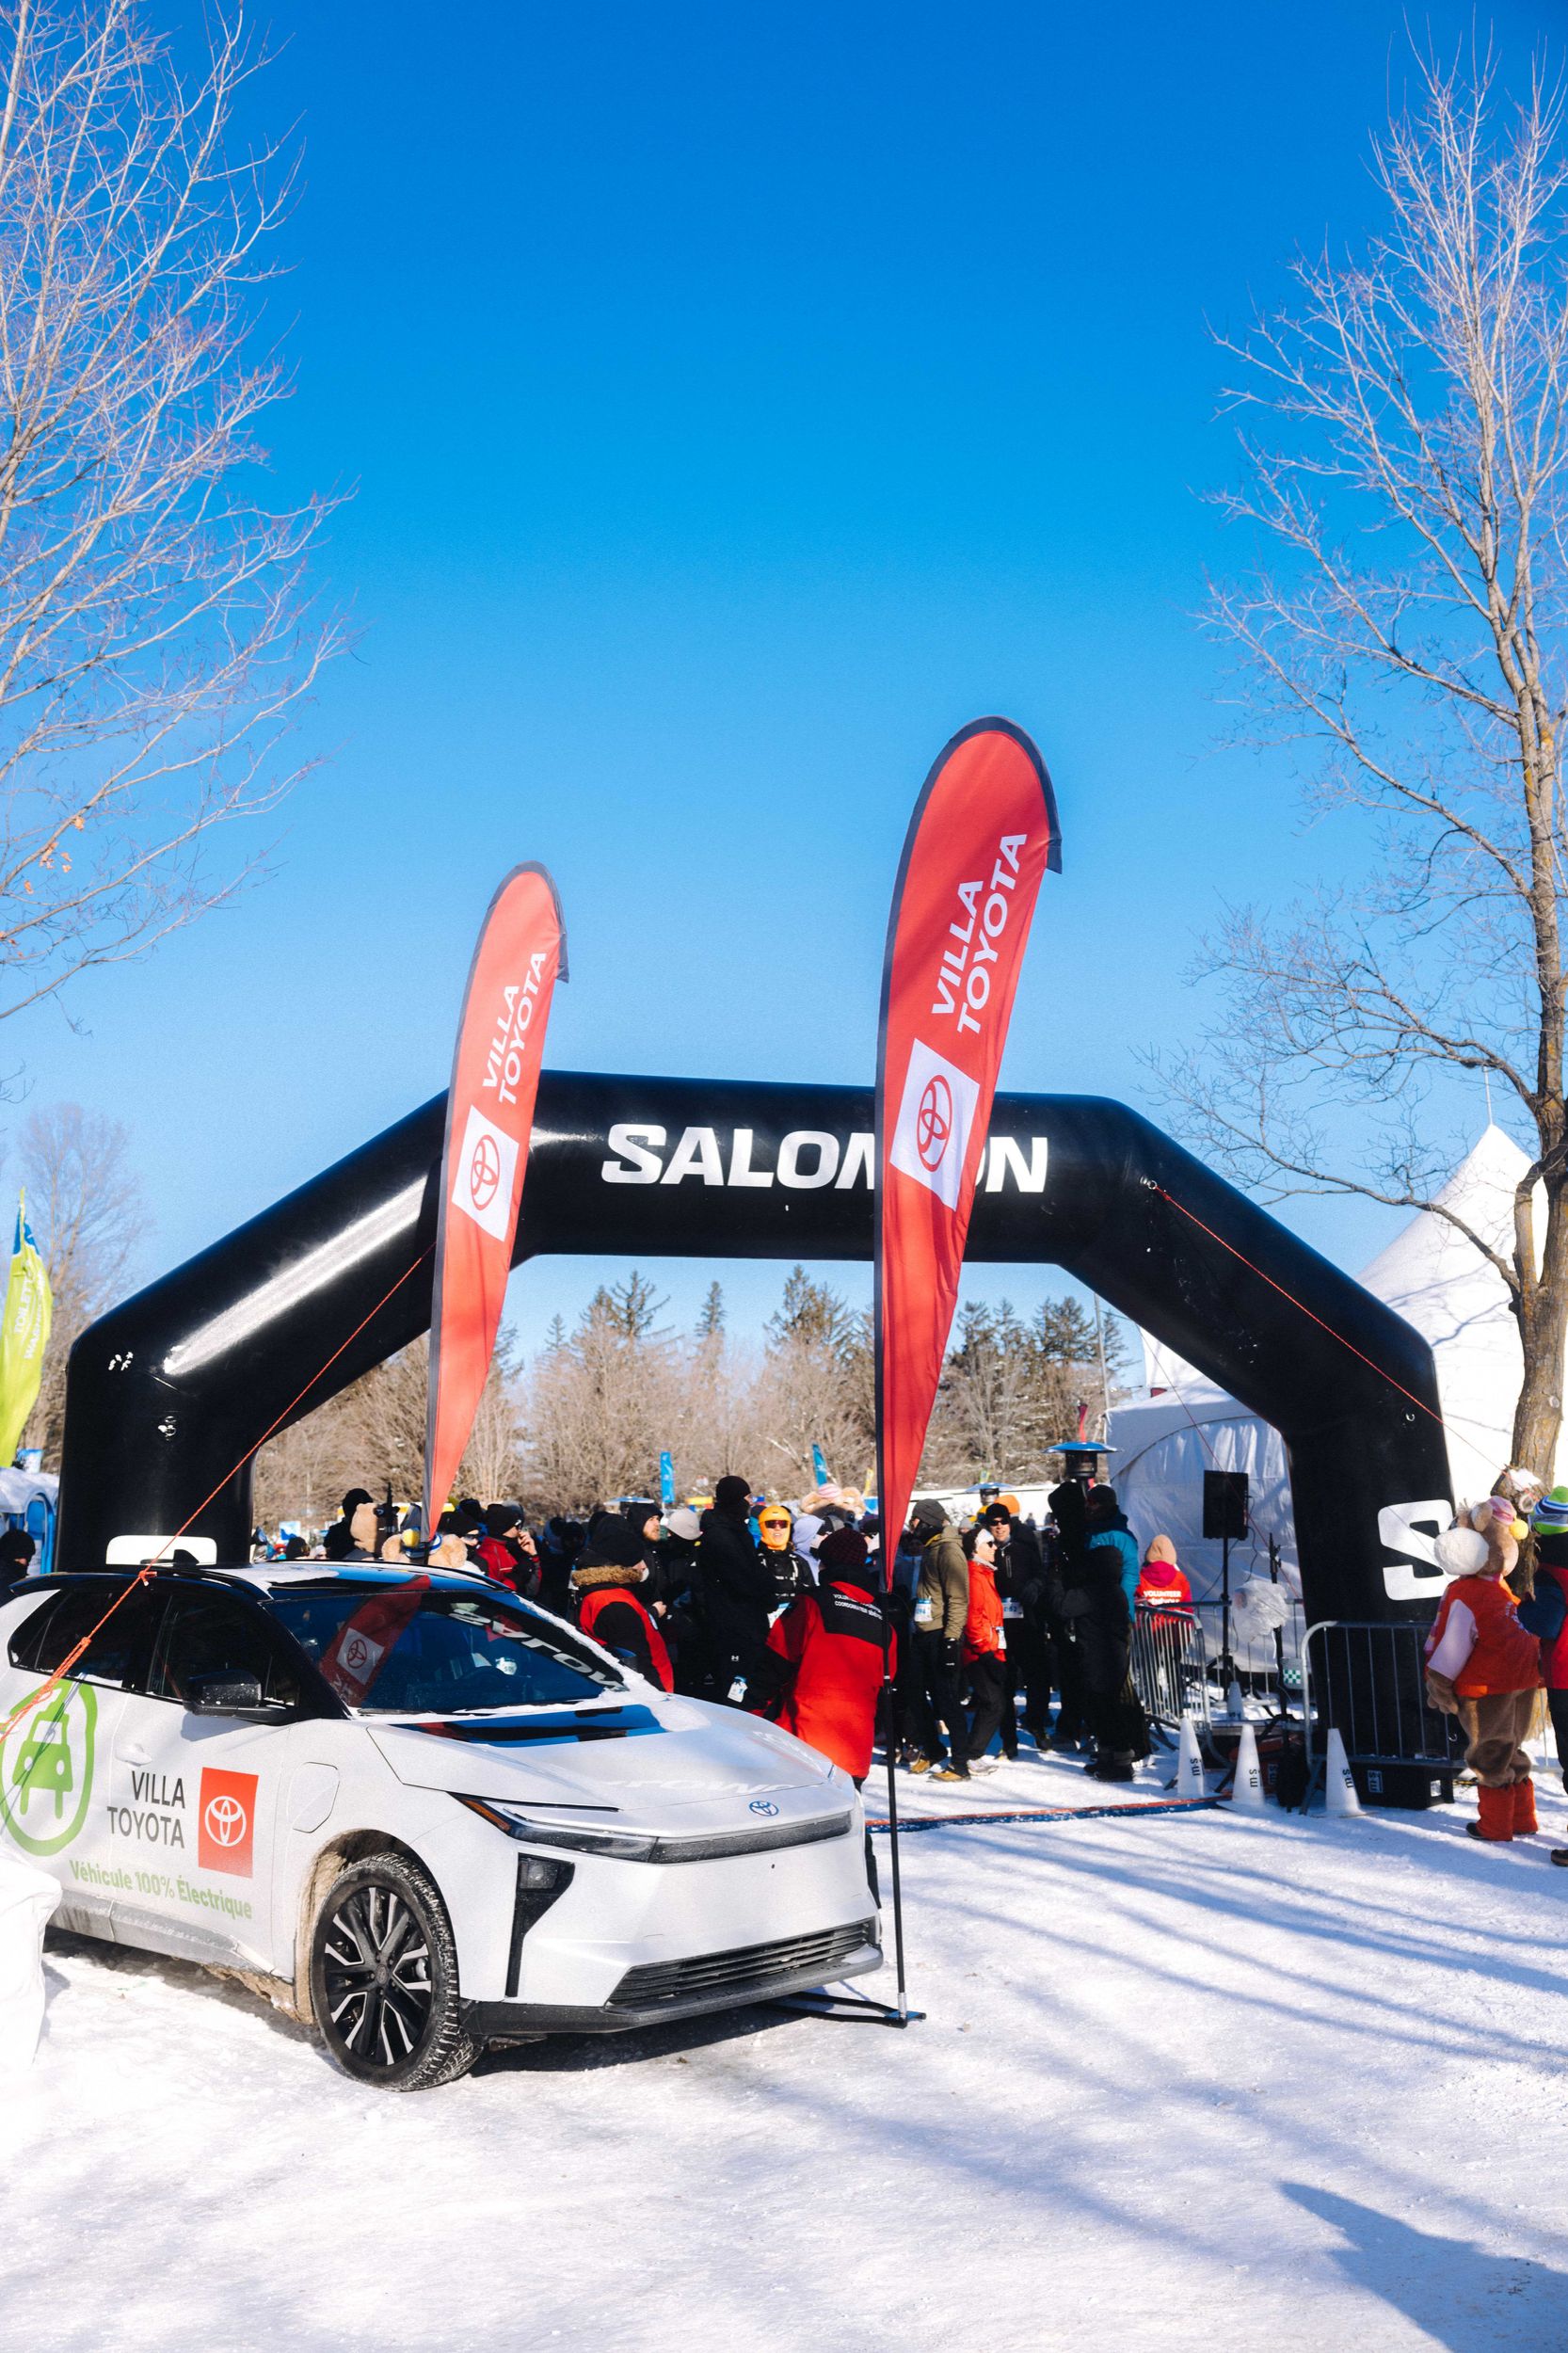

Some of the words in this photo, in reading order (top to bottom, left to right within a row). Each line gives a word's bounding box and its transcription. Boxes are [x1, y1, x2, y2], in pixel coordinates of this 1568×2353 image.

[931, 880, 984, 1015] VILLA
[957, 834, 1028, 1033] TOYOTA
[482, 985, 520, 1088] VILLA
[499, 952, 547, 1105] TOYOTA
[600, 1123, 1049, 1193] SALON
[106, 1806, 185, 1849] TOYOTA
[131, 1770, 185, 1809] VILLA
[69, 1859, 133, 1890] Véhicule
[135, 1869, 175, 1899] 100%
[176, 1874, 253, 1921] Électrique
